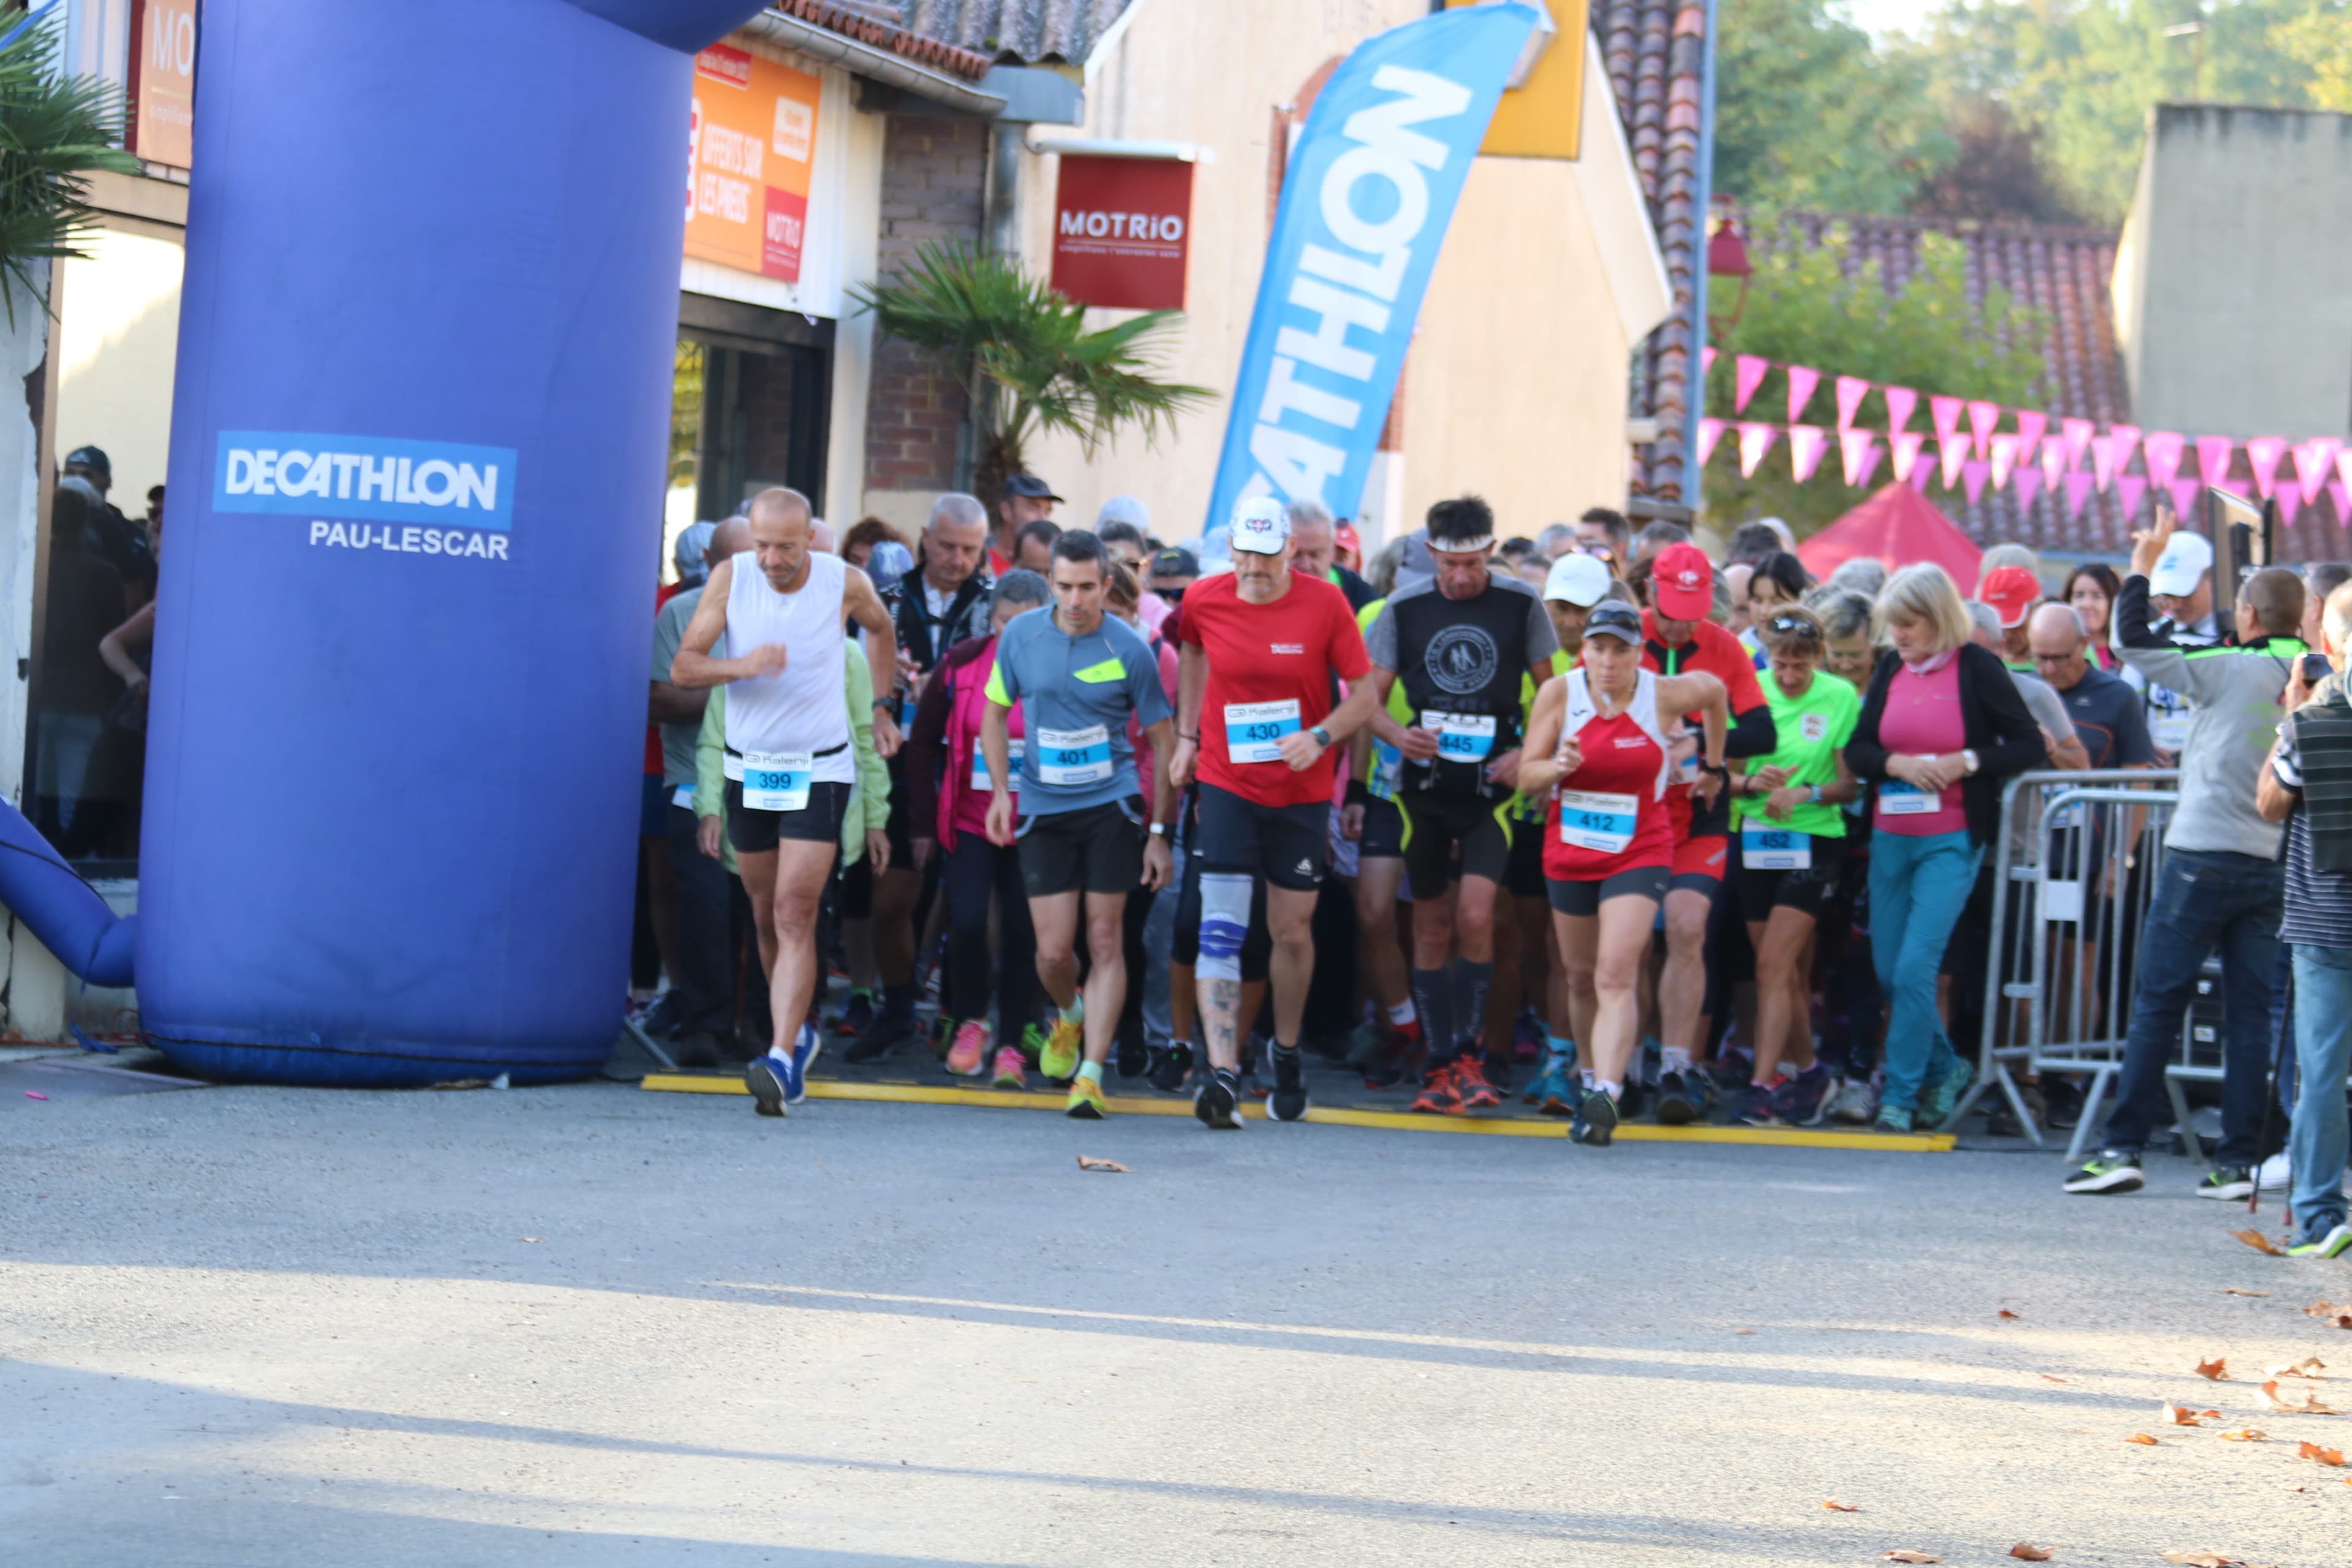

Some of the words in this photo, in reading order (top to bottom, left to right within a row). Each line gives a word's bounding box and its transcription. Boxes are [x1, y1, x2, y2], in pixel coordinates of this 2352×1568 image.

[1234, 64, 1472, 510] ATHLON
[225, 449, 498, 511] DECATHLON
[309, 521, 509, 560] PAU-LESCAR
[1246, 723, 1281, 740] 430
[1439, 736, 1472, 752] 445
[763, 754, 809, 766] Kalenji
[1057, 750, 1089, 765] 401
[759, 773, 791, 790] 399
[1580, 814, 1614, 832] 412
[1759, 833, 1790, 850] 452
